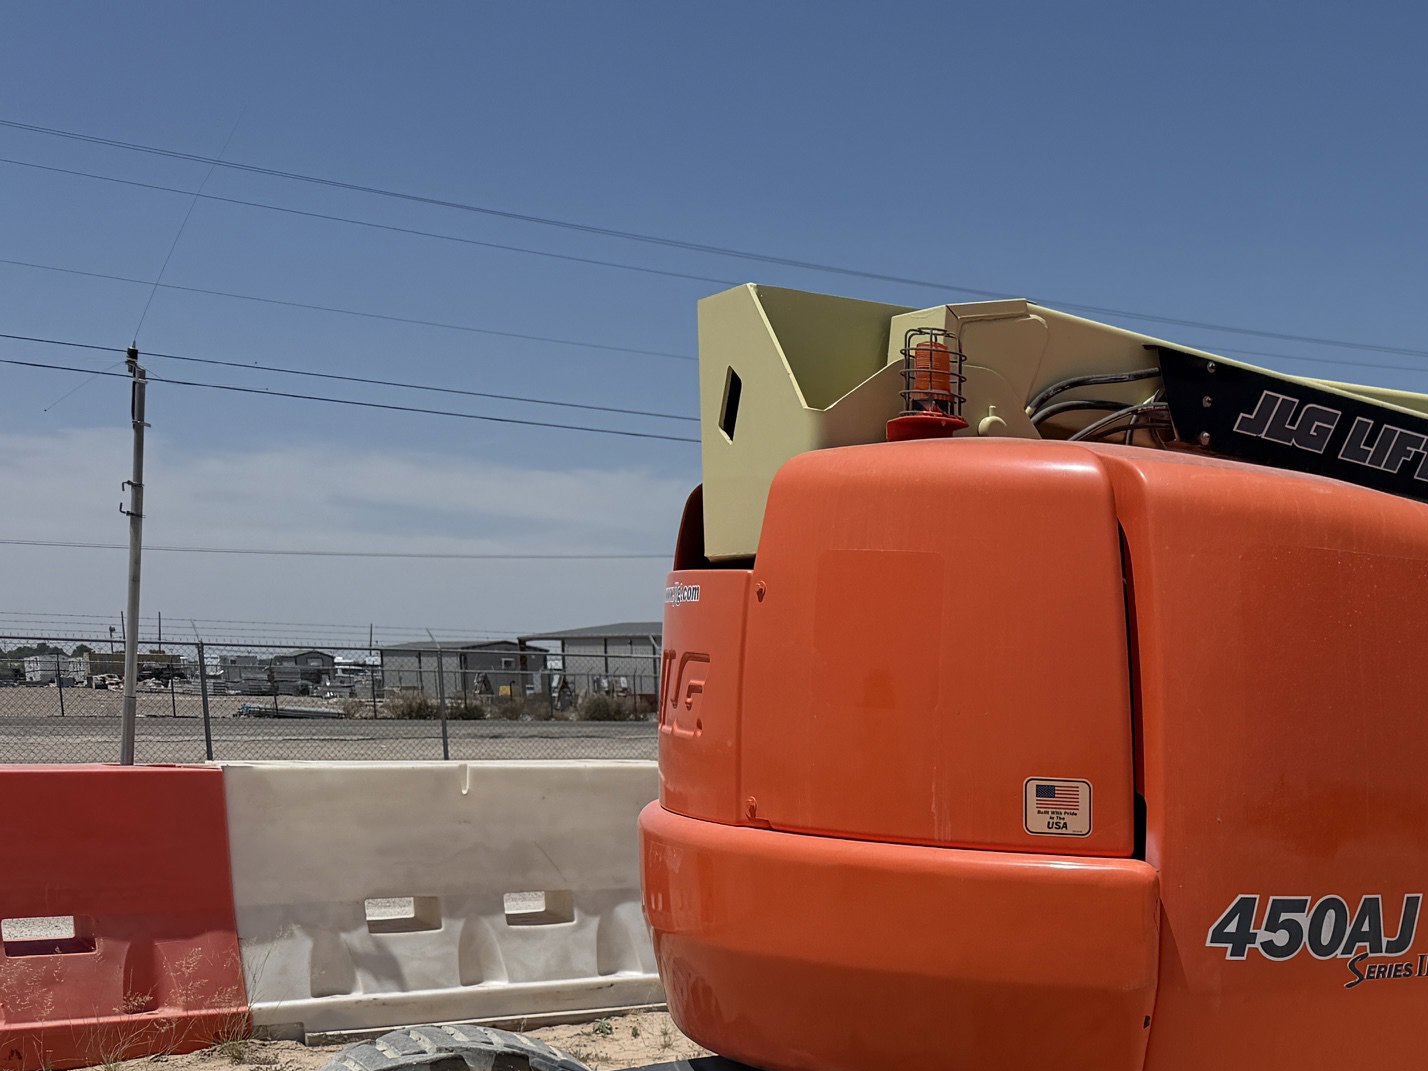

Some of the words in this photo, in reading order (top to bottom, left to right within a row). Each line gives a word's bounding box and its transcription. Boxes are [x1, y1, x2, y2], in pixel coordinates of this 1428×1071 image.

[1233, 390, 1342, 454] JLG
[1047, 821, 1068, 830] USA
[1205, 893, 1423, 962] 450AJ
